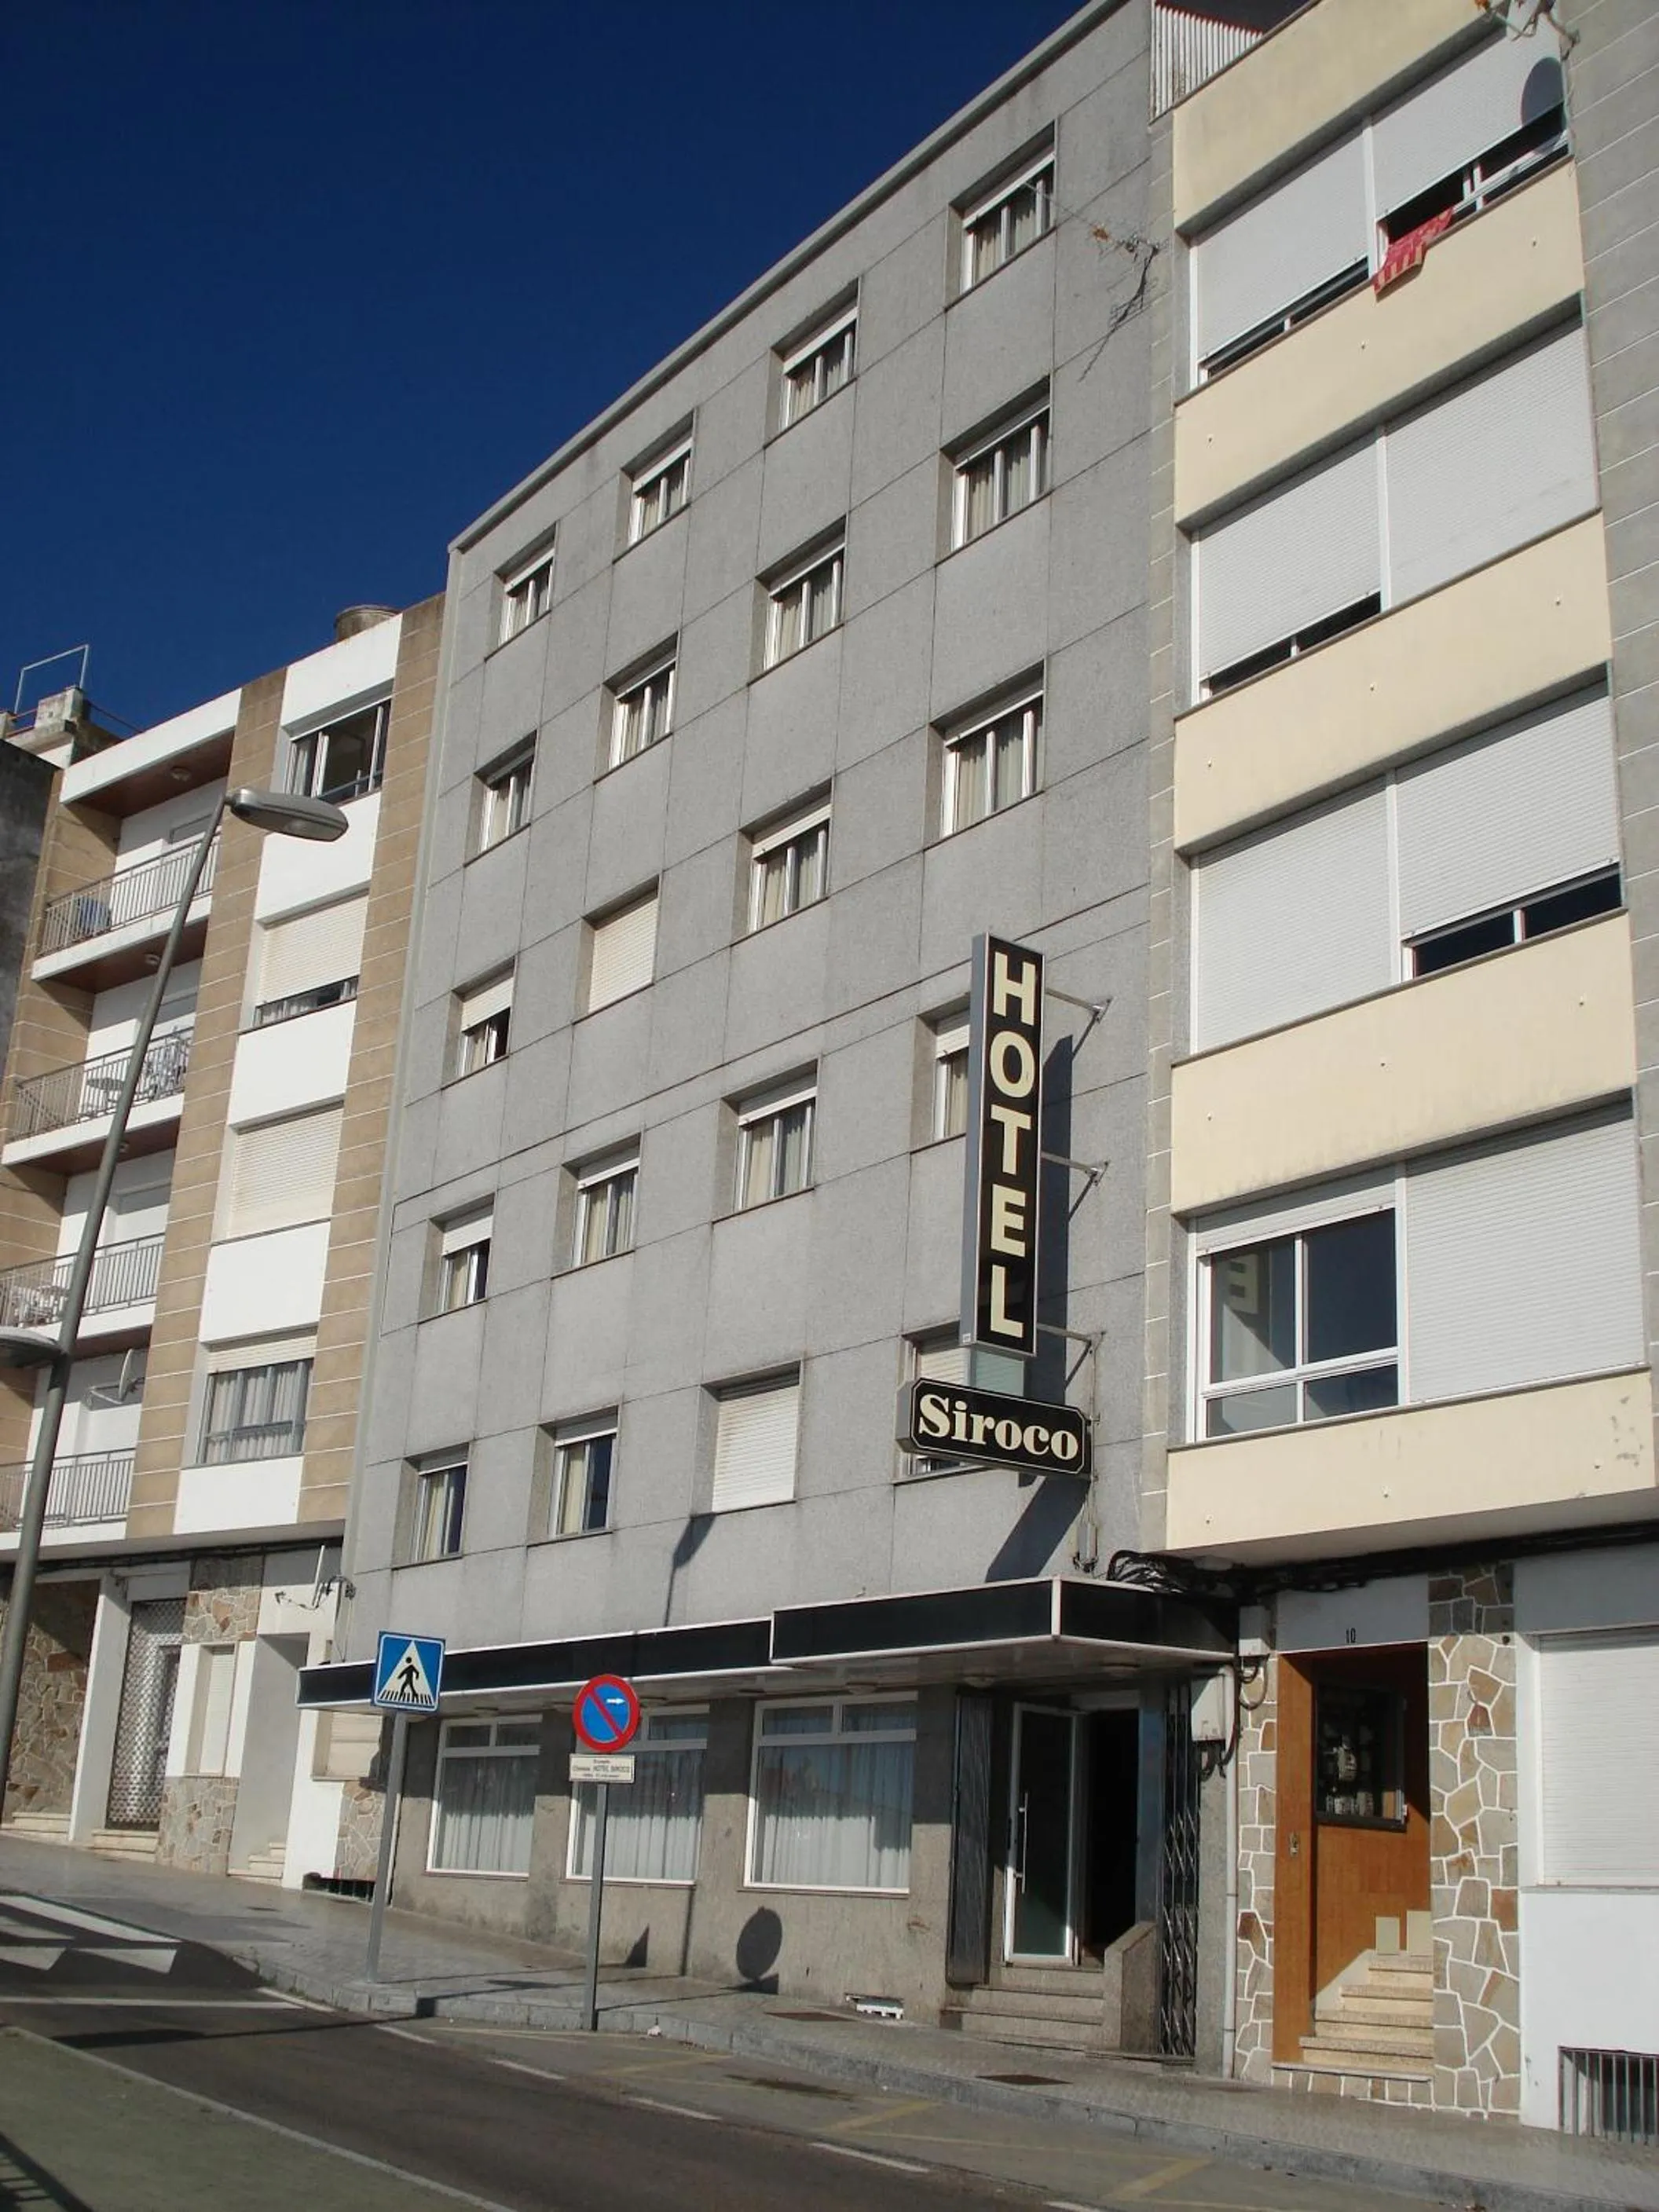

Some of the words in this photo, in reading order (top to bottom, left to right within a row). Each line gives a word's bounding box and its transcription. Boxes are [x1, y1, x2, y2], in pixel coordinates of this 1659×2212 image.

[990, 950, 1036, 1339] HOTEL
[918, 1394, 1079, 1461] Siroco
[1346, 1627, 1356, 1643] 10
